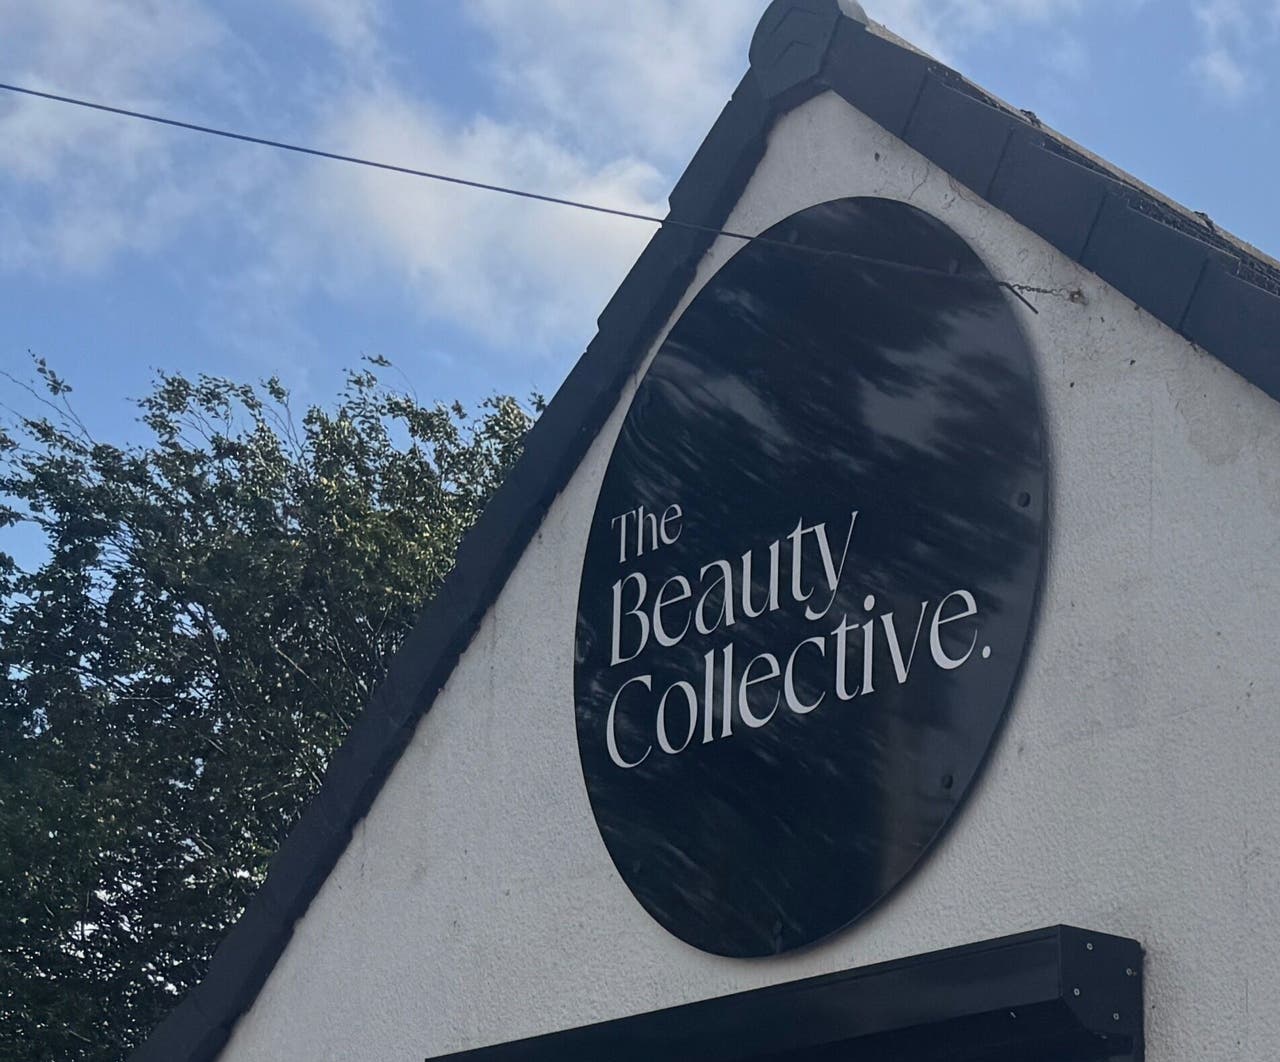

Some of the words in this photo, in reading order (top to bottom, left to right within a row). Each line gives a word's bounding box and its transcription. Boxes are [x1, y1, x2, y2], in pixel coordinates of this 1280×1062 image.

[609, 510, 859, 667] Beauty
[611, 503, 683, 563] The
[606, 589, 992, 769] Collective.
